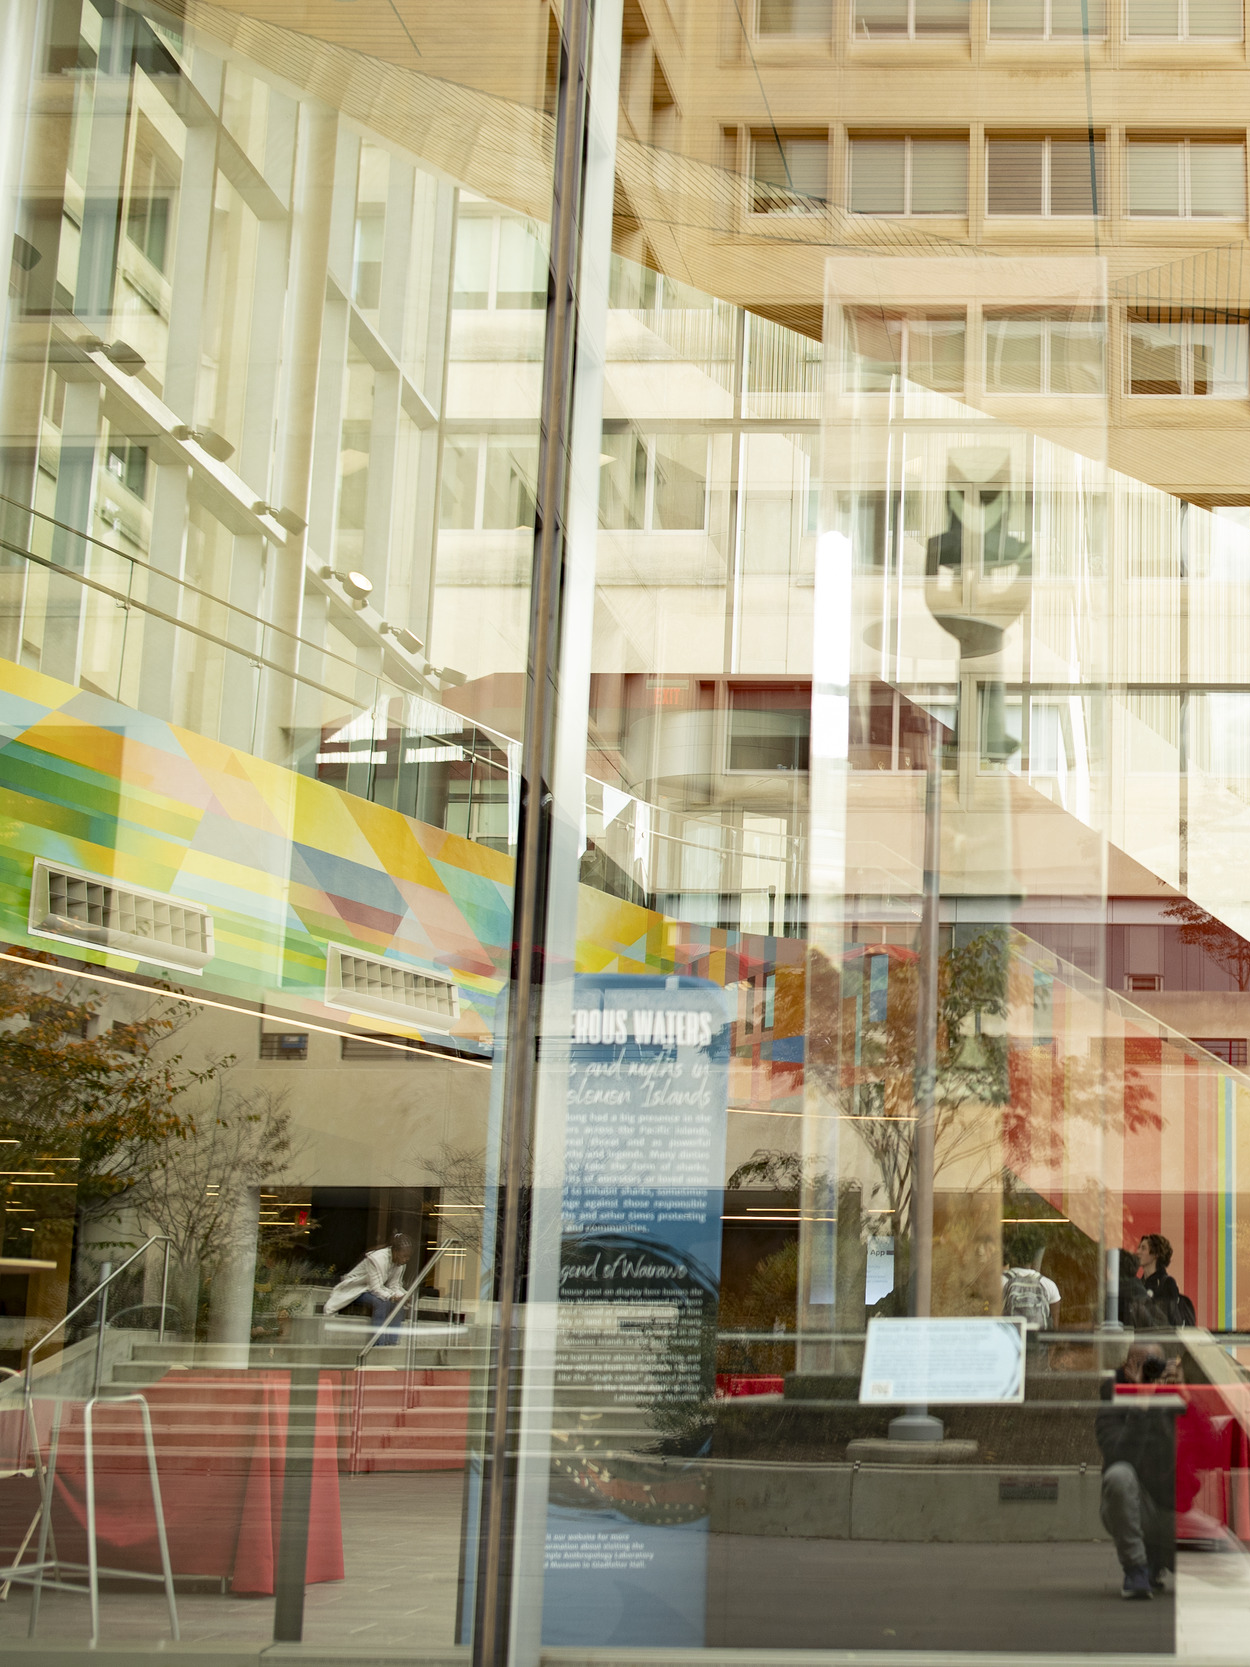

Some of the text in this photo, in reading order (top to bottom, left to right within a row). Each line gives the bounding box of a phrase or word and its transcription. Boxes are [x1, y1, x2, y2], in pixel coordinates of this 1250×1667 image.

[633, 1009, 712, 1046] WATERS
[585, 1046, 628, 1082] and
[627, 1050, 684, 1090] myths
[566, 1076, 713, 1110] olomon Islands
[590, 1112, 608, 1122] had
[682, 1113, 693, 1122] in
[695, 1113, 712, 1122] the
[626, 1137, 645, 1146] and
[599, 1212, 626, 1220] other
[565, 1224, 584, 1232] and
[560, 1252, 601, 1286] gend
[603, 1253, 627, 1280] of
[615, 1288, 643, 1298] display
[690, 1288, 704, 1296] the
